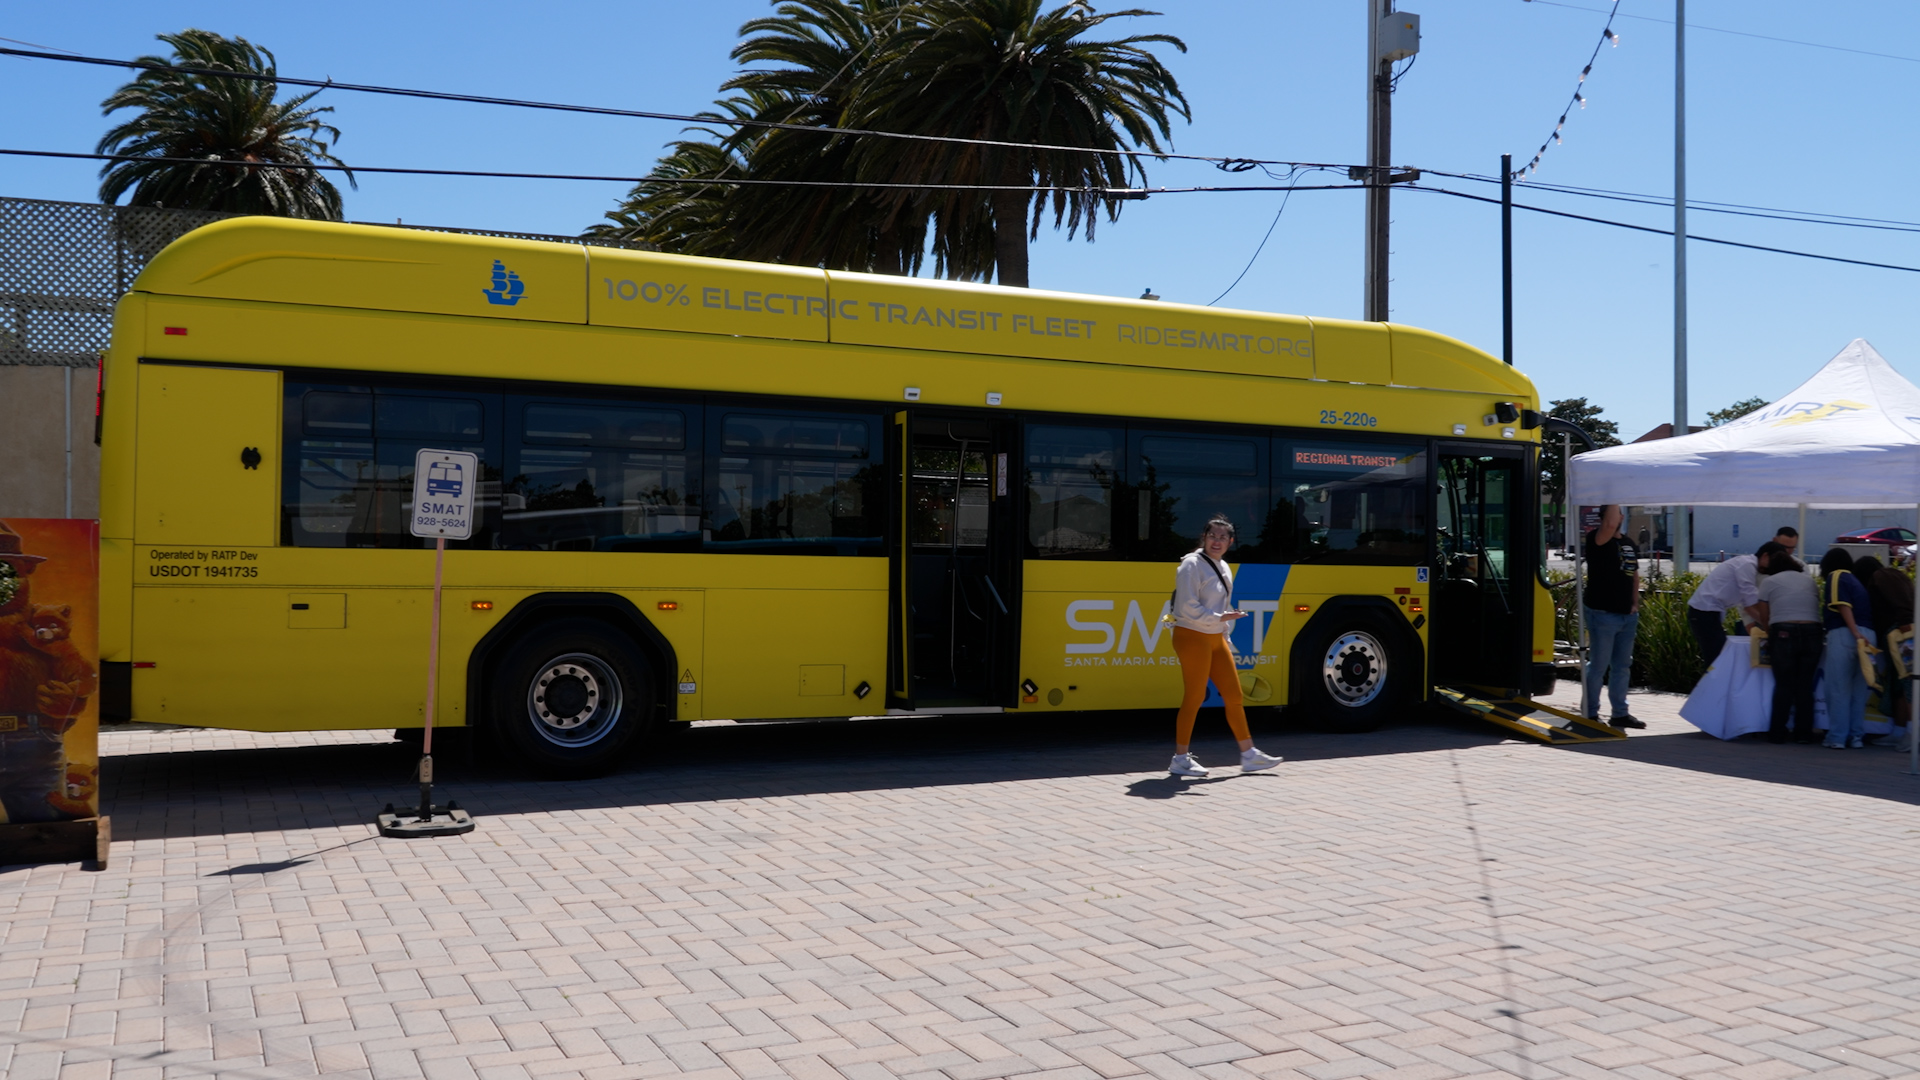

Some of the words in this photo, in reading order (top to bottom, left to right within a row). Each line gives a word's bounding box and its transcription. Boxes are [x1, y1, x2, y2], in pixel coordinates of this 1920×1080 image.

[603, 277, 691, 307] 100%
[702, 287, 860, 321] ELECTRIC
[868, 301, 1003, 333] TRANSIT
[1012, 313, 1097, 340] FLEET
[1117, 323, 1312, 359] RIDESMRT.ORG
[1319, 409, 1378, 428] 25-220e
[1295, 452, 1350, 466] REGIONAL
[1350, 454, 1397, 468] TRANSIT
[421, 501, 465, 516] SMAT
[417, 516, 466, 528] 928-5624
[150, 549, 195, 562] Operated
[197, 550, 209, 562] by
[211, 550, 238, 560] RATP
[240, 551, 258, 561] Dev
[150, 565, 201, 577] USDOT
[204, 565, 259, 578] 1941735
[1065, 599, 1279, 654] SMT
[1064, 656, 1108, 667] SANTA
[1111, 656, 1156, 667] MARIA
[1233, 654, 1278, 666] RANSIT
